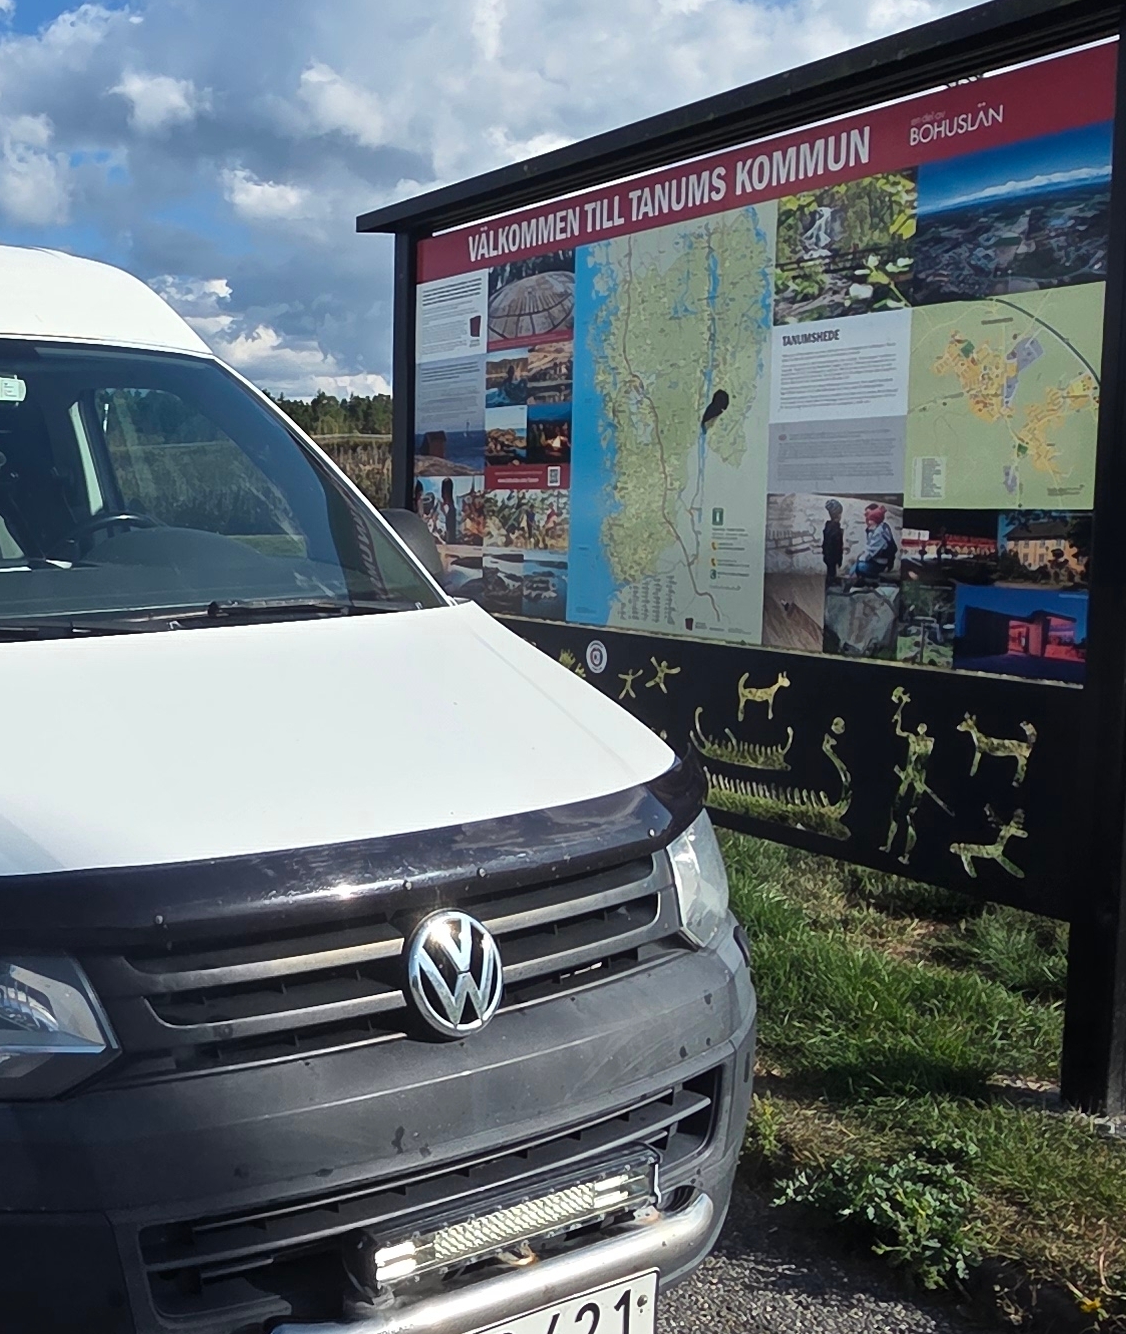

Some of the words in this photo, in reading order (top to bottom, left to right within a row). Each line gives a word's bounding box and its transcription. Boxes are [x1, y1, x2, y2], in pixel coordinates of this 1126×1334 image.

[910, 102, 1004, 146] BOHUSLÄN
[468, 205, 580, 262] VÄLKOMMEN
[584, 195, 625, 233] TILL
[629, 167, 727, 222] TANUMS
[735, 126, 871, 195] KOMMUN
[782, 329, 841, 346] TANUMSHEDE
[415, 913, 501, 1032] VW
